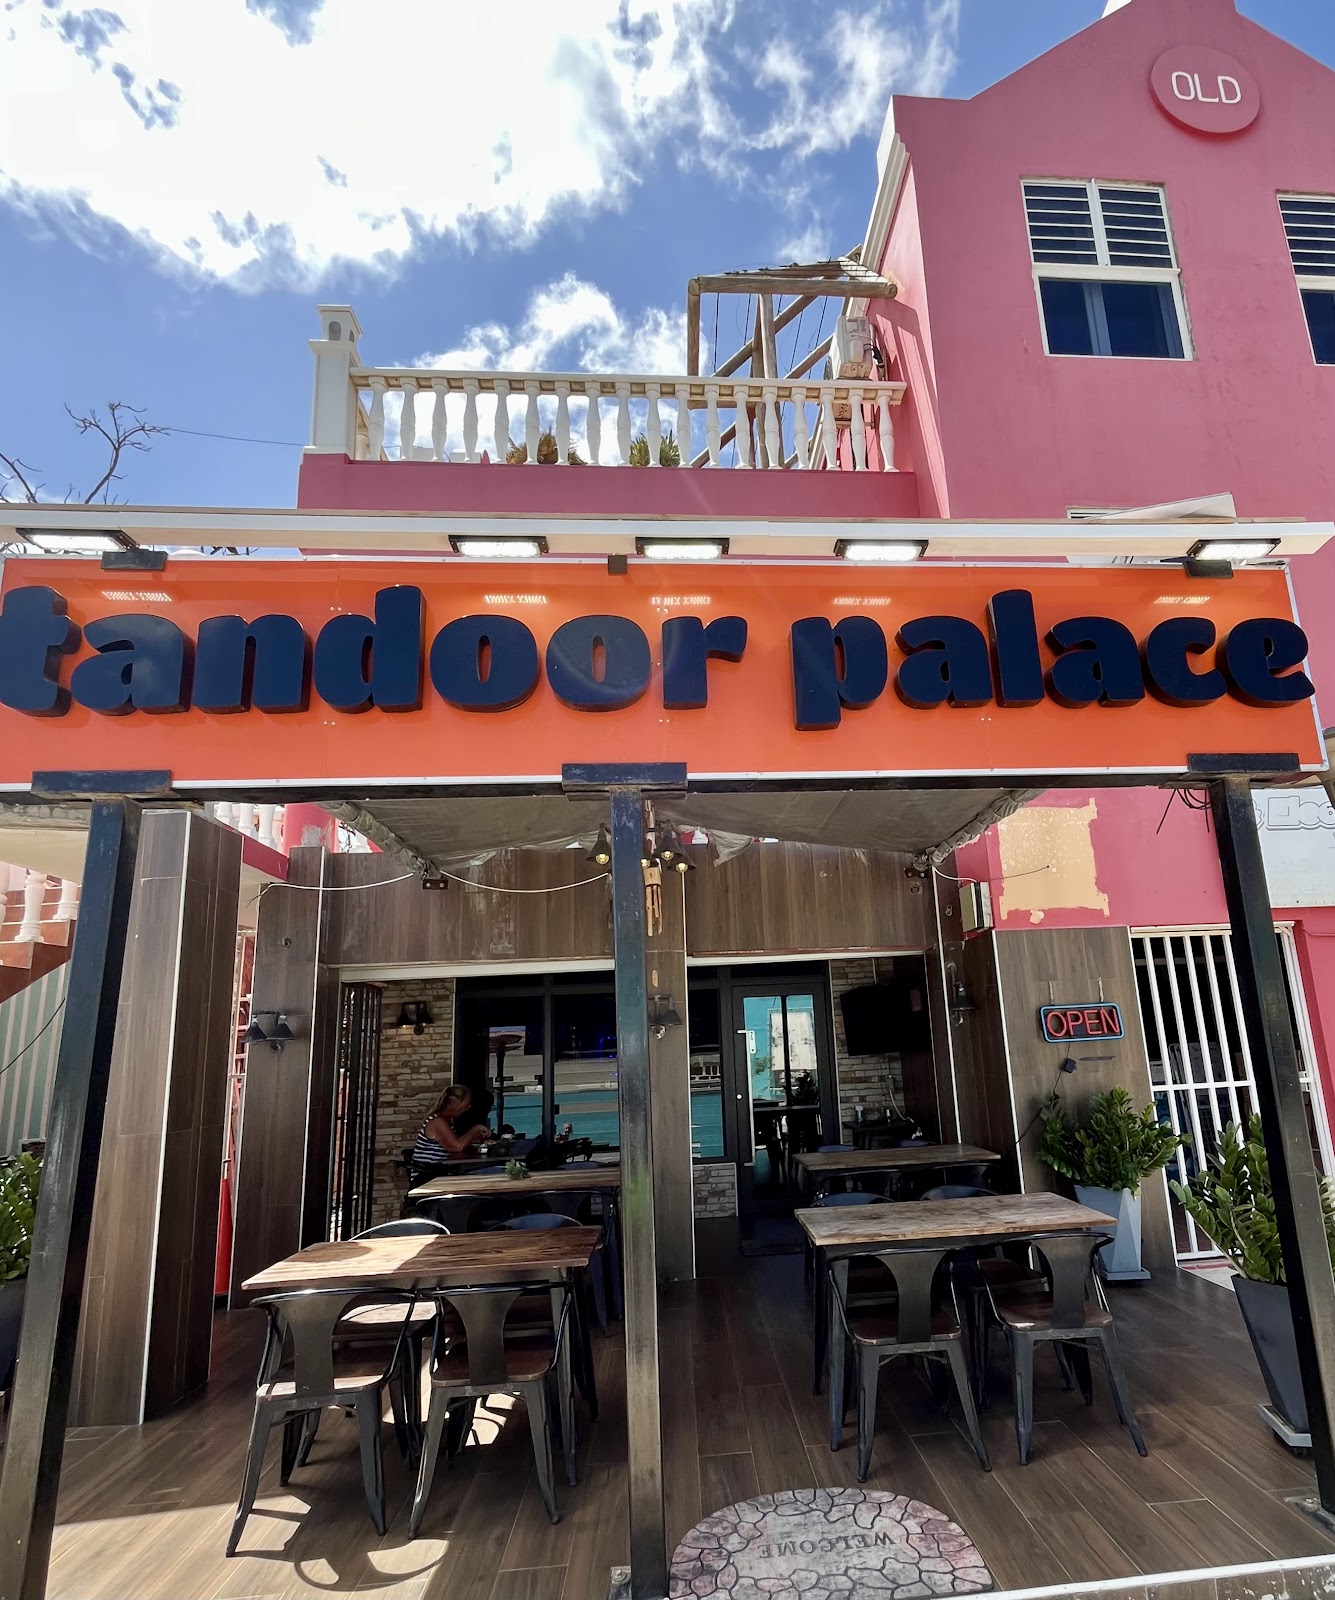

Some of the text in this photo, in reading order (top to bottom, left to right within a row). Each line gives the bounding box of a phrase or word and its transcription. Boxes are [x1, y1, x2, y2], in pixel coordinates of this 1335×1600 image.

[1171, 71, 1241, 104] OLD
[0, 585, 1316, 731] tandoor palace
[1046, 1007, 1120, 1037] OPEN
[757, 1532, 897, 1559] WELCOME
